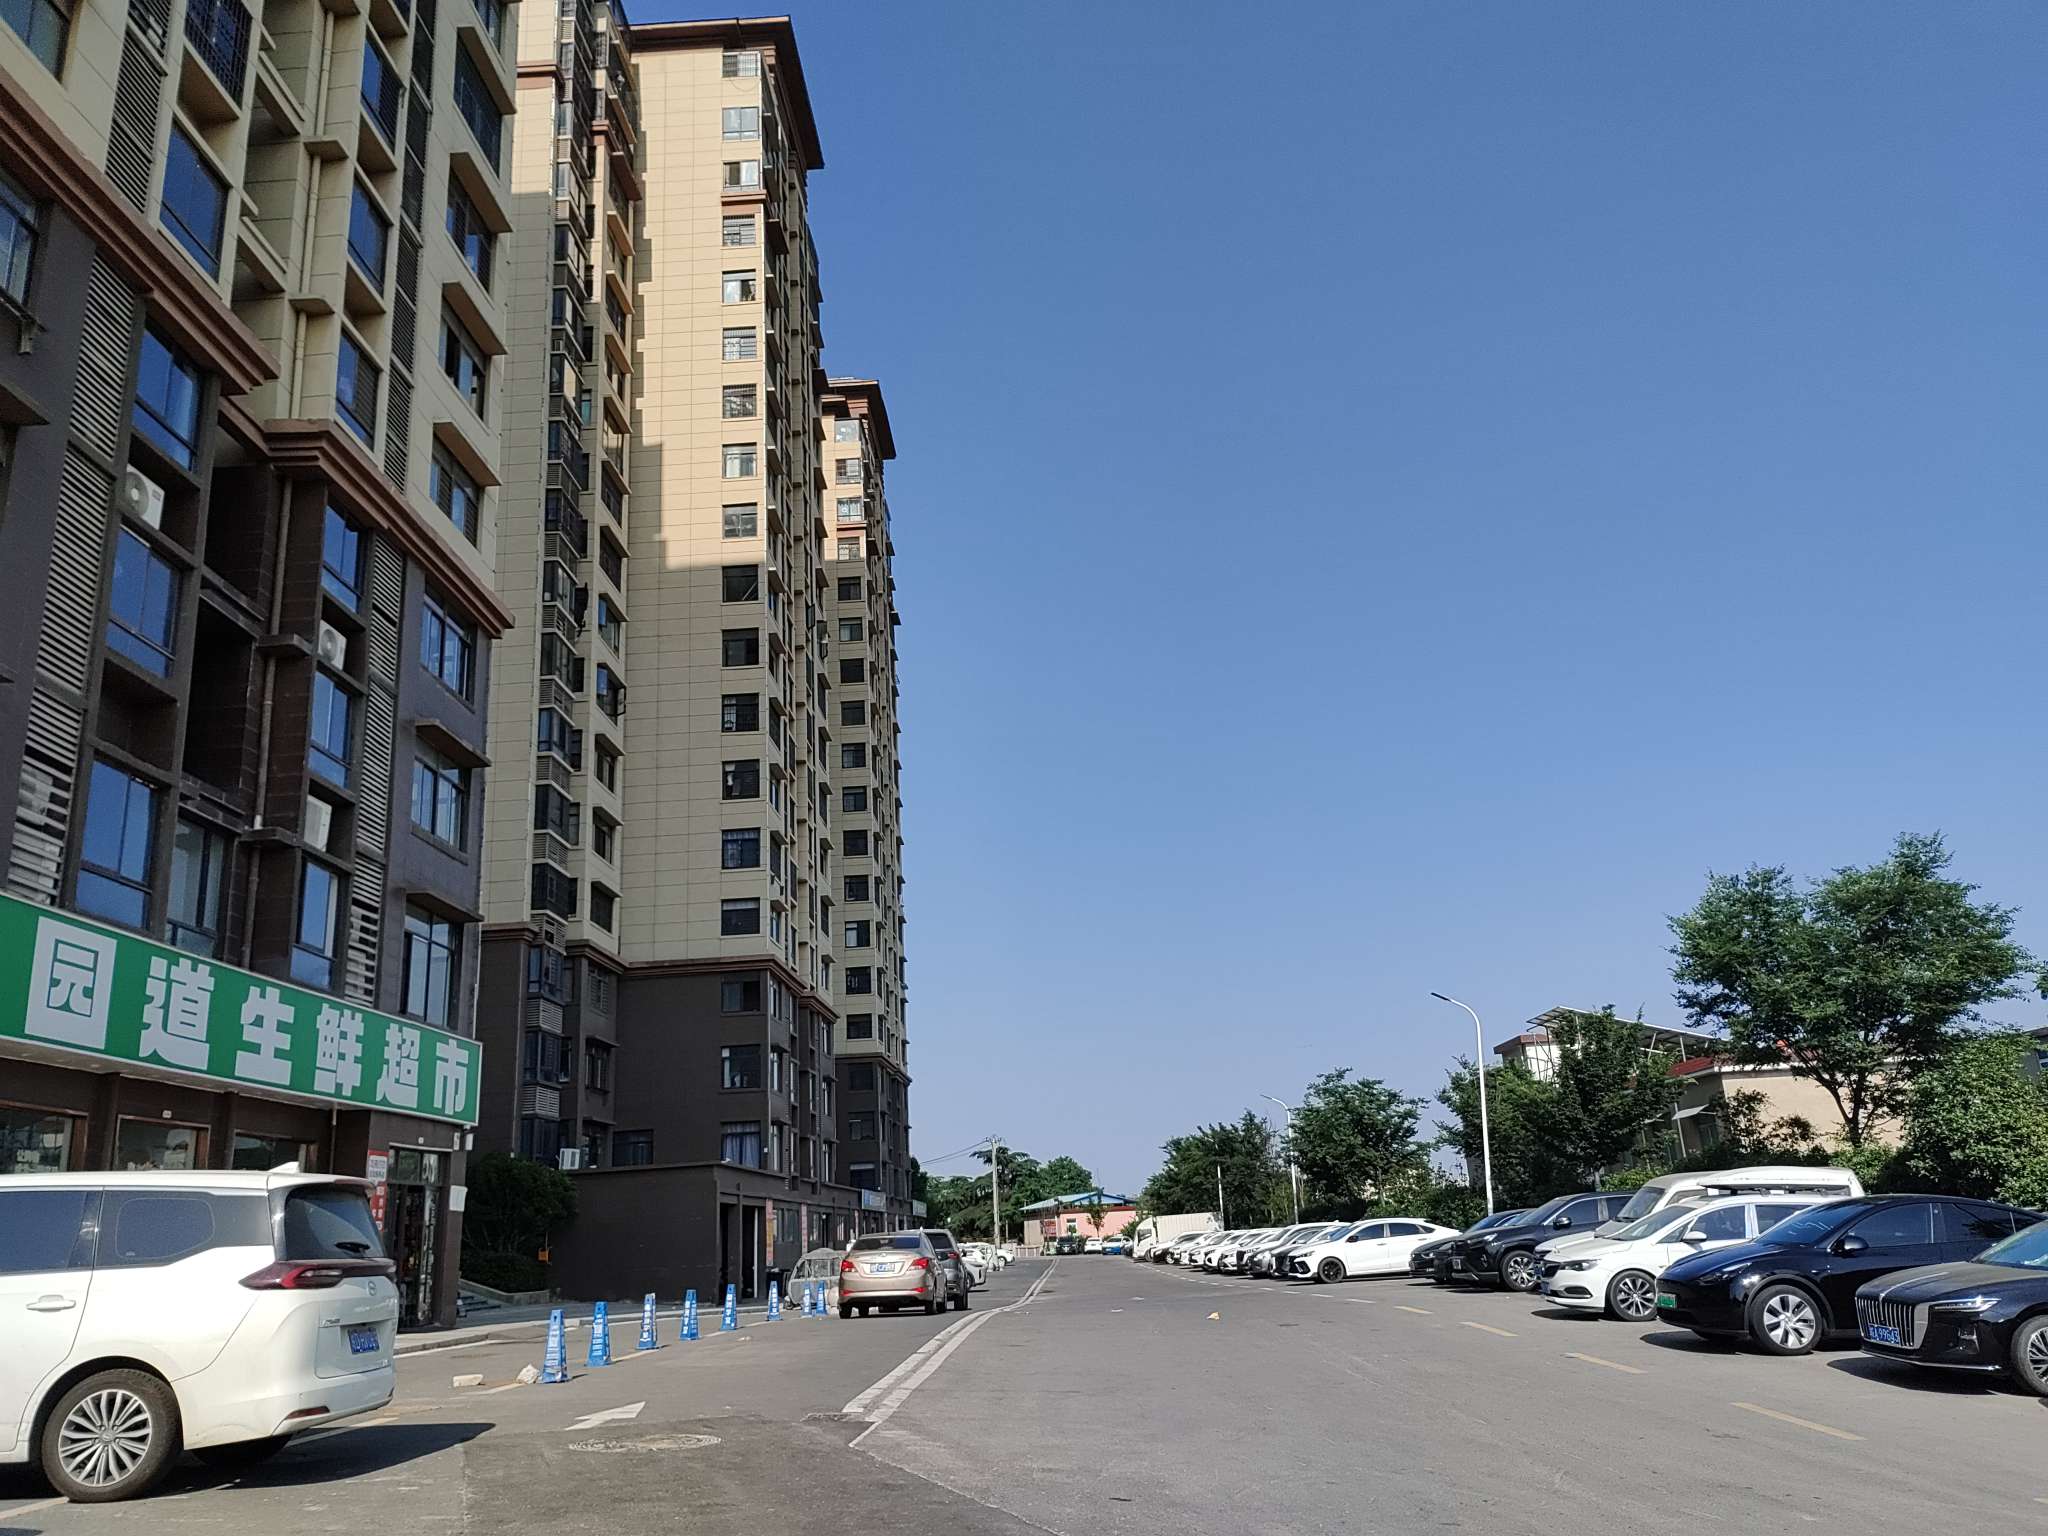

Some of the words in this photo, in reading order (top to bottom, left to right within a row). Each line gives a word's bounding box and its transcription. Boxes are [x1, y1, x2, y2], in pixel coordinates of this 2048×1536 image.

[25, 917, 469, 1115] 园道生鲜超市
